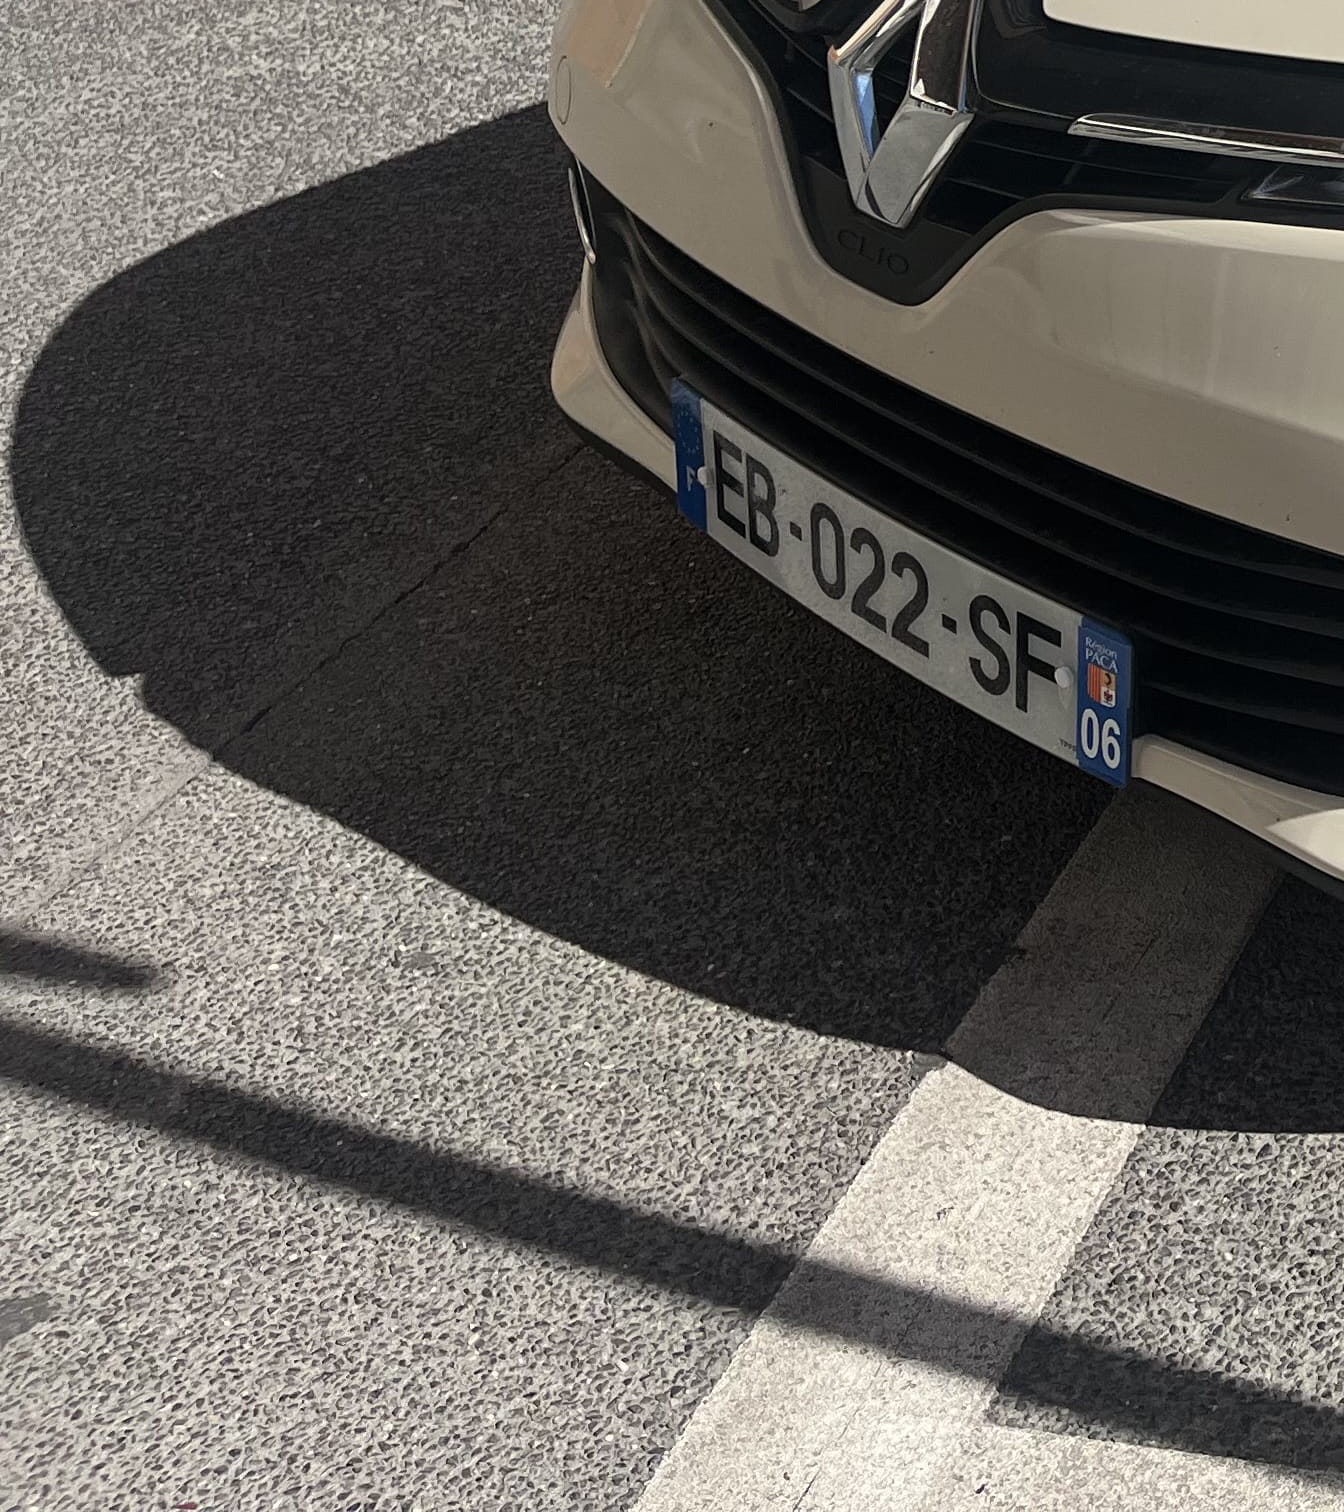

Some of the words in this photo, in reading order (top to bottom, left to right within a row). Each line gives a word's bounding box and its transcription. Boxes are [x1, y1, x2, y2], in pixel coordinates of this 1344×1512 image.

[838, 230, 909, 274] CLIO
[712, 430, 1062, 713] EB-022-SF
[1086, 648, 1118, 674] PACA
[1081, 708, 1121, 769] 06
